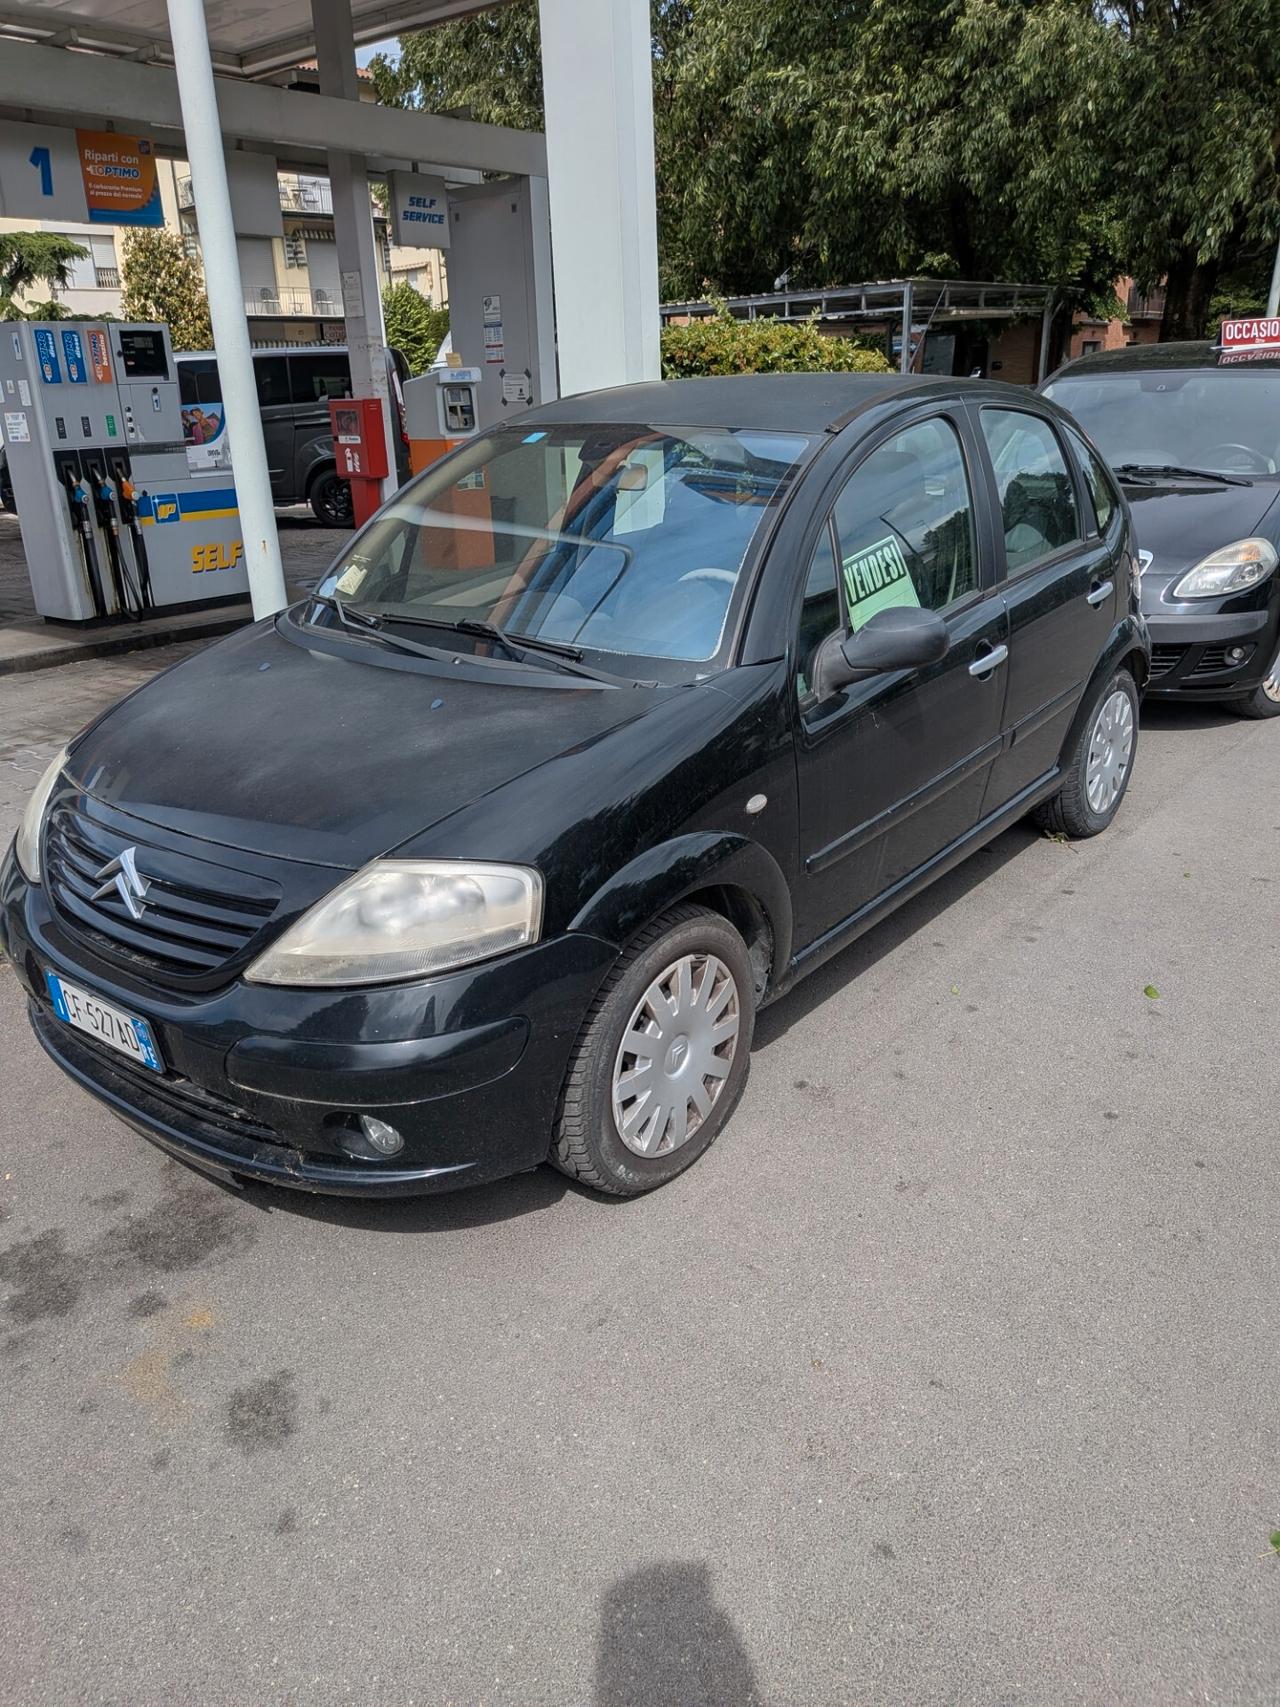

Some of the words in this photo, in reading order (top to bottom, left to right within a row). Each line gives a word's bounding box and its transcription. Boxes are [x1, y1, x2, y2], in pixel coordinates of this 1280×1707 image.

[84, 149, 118, 163] Riparti
[120, 155, 139, 165] con
[29, 147, 54, 196] 1
[408, 196, 437, 208] SELF
[402, 210, 445, 225] SERVICE
[1225, 320, 1280, 339] OCCASIO
[191, 543, 243, 573] SELF
[843, 543, 905, 604] VENDESI
